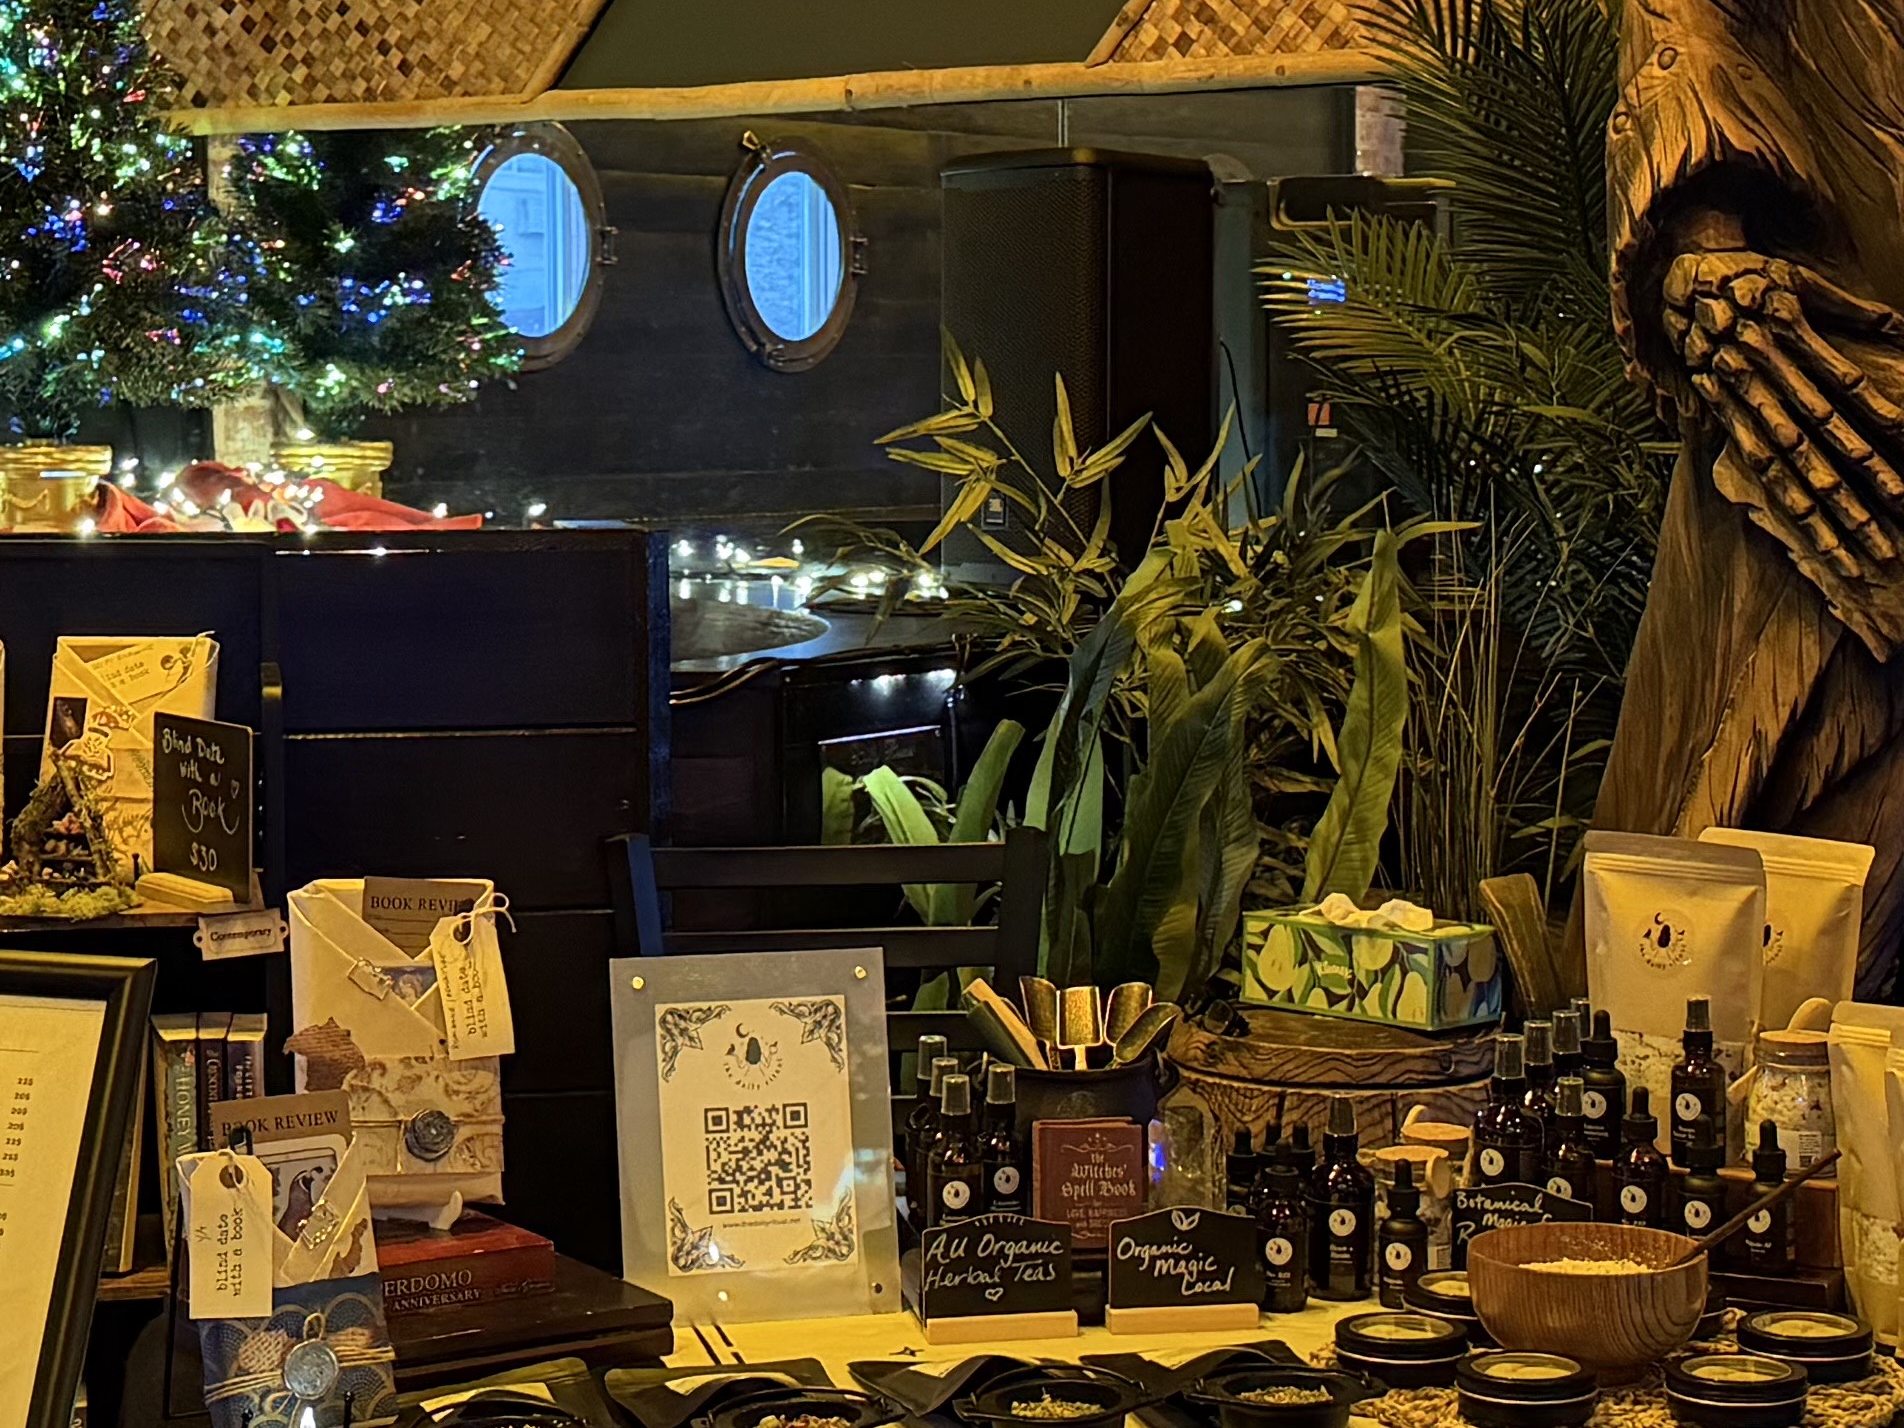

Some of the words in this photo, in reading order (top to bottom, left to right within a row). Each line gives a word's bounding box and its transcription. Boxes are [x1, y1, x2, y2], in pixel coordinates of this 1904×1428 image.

[162, 727, 192, 754] Blind
[197, 736, 225, 765] Date
[190, 841, 218, 872] $30
[458, 965, 471, 994] date
[463, 1000, 477, 1036] blind
[175, 1075, 191, 1138] HONEY
[1061, 1180, 1094, 1201] Spell
[1099, 1179, 1137, 1198] Book
[1456, 1190, 1544, 1214] Botanical
[216, 1214, 228, 1246] date
[230, 1208, 243, 1242] book
[232, 1248, 243, 1257] a
[926, 1233, 966, 1263] All
[977, 1233, 1065, 1269] Organic
[1116, 1236, 1193, 1271] Organic
[216, 1251, 228, 1291] blind
[230, 1262, 243, 1297] with
[383, 1269, 472, 1298] ERDOMO
[924, 1261, 1001, 1293] Herbal
[1010, 1261, 1056, 1283] Teas
[1181, 1270, 1236, 1297] Local
